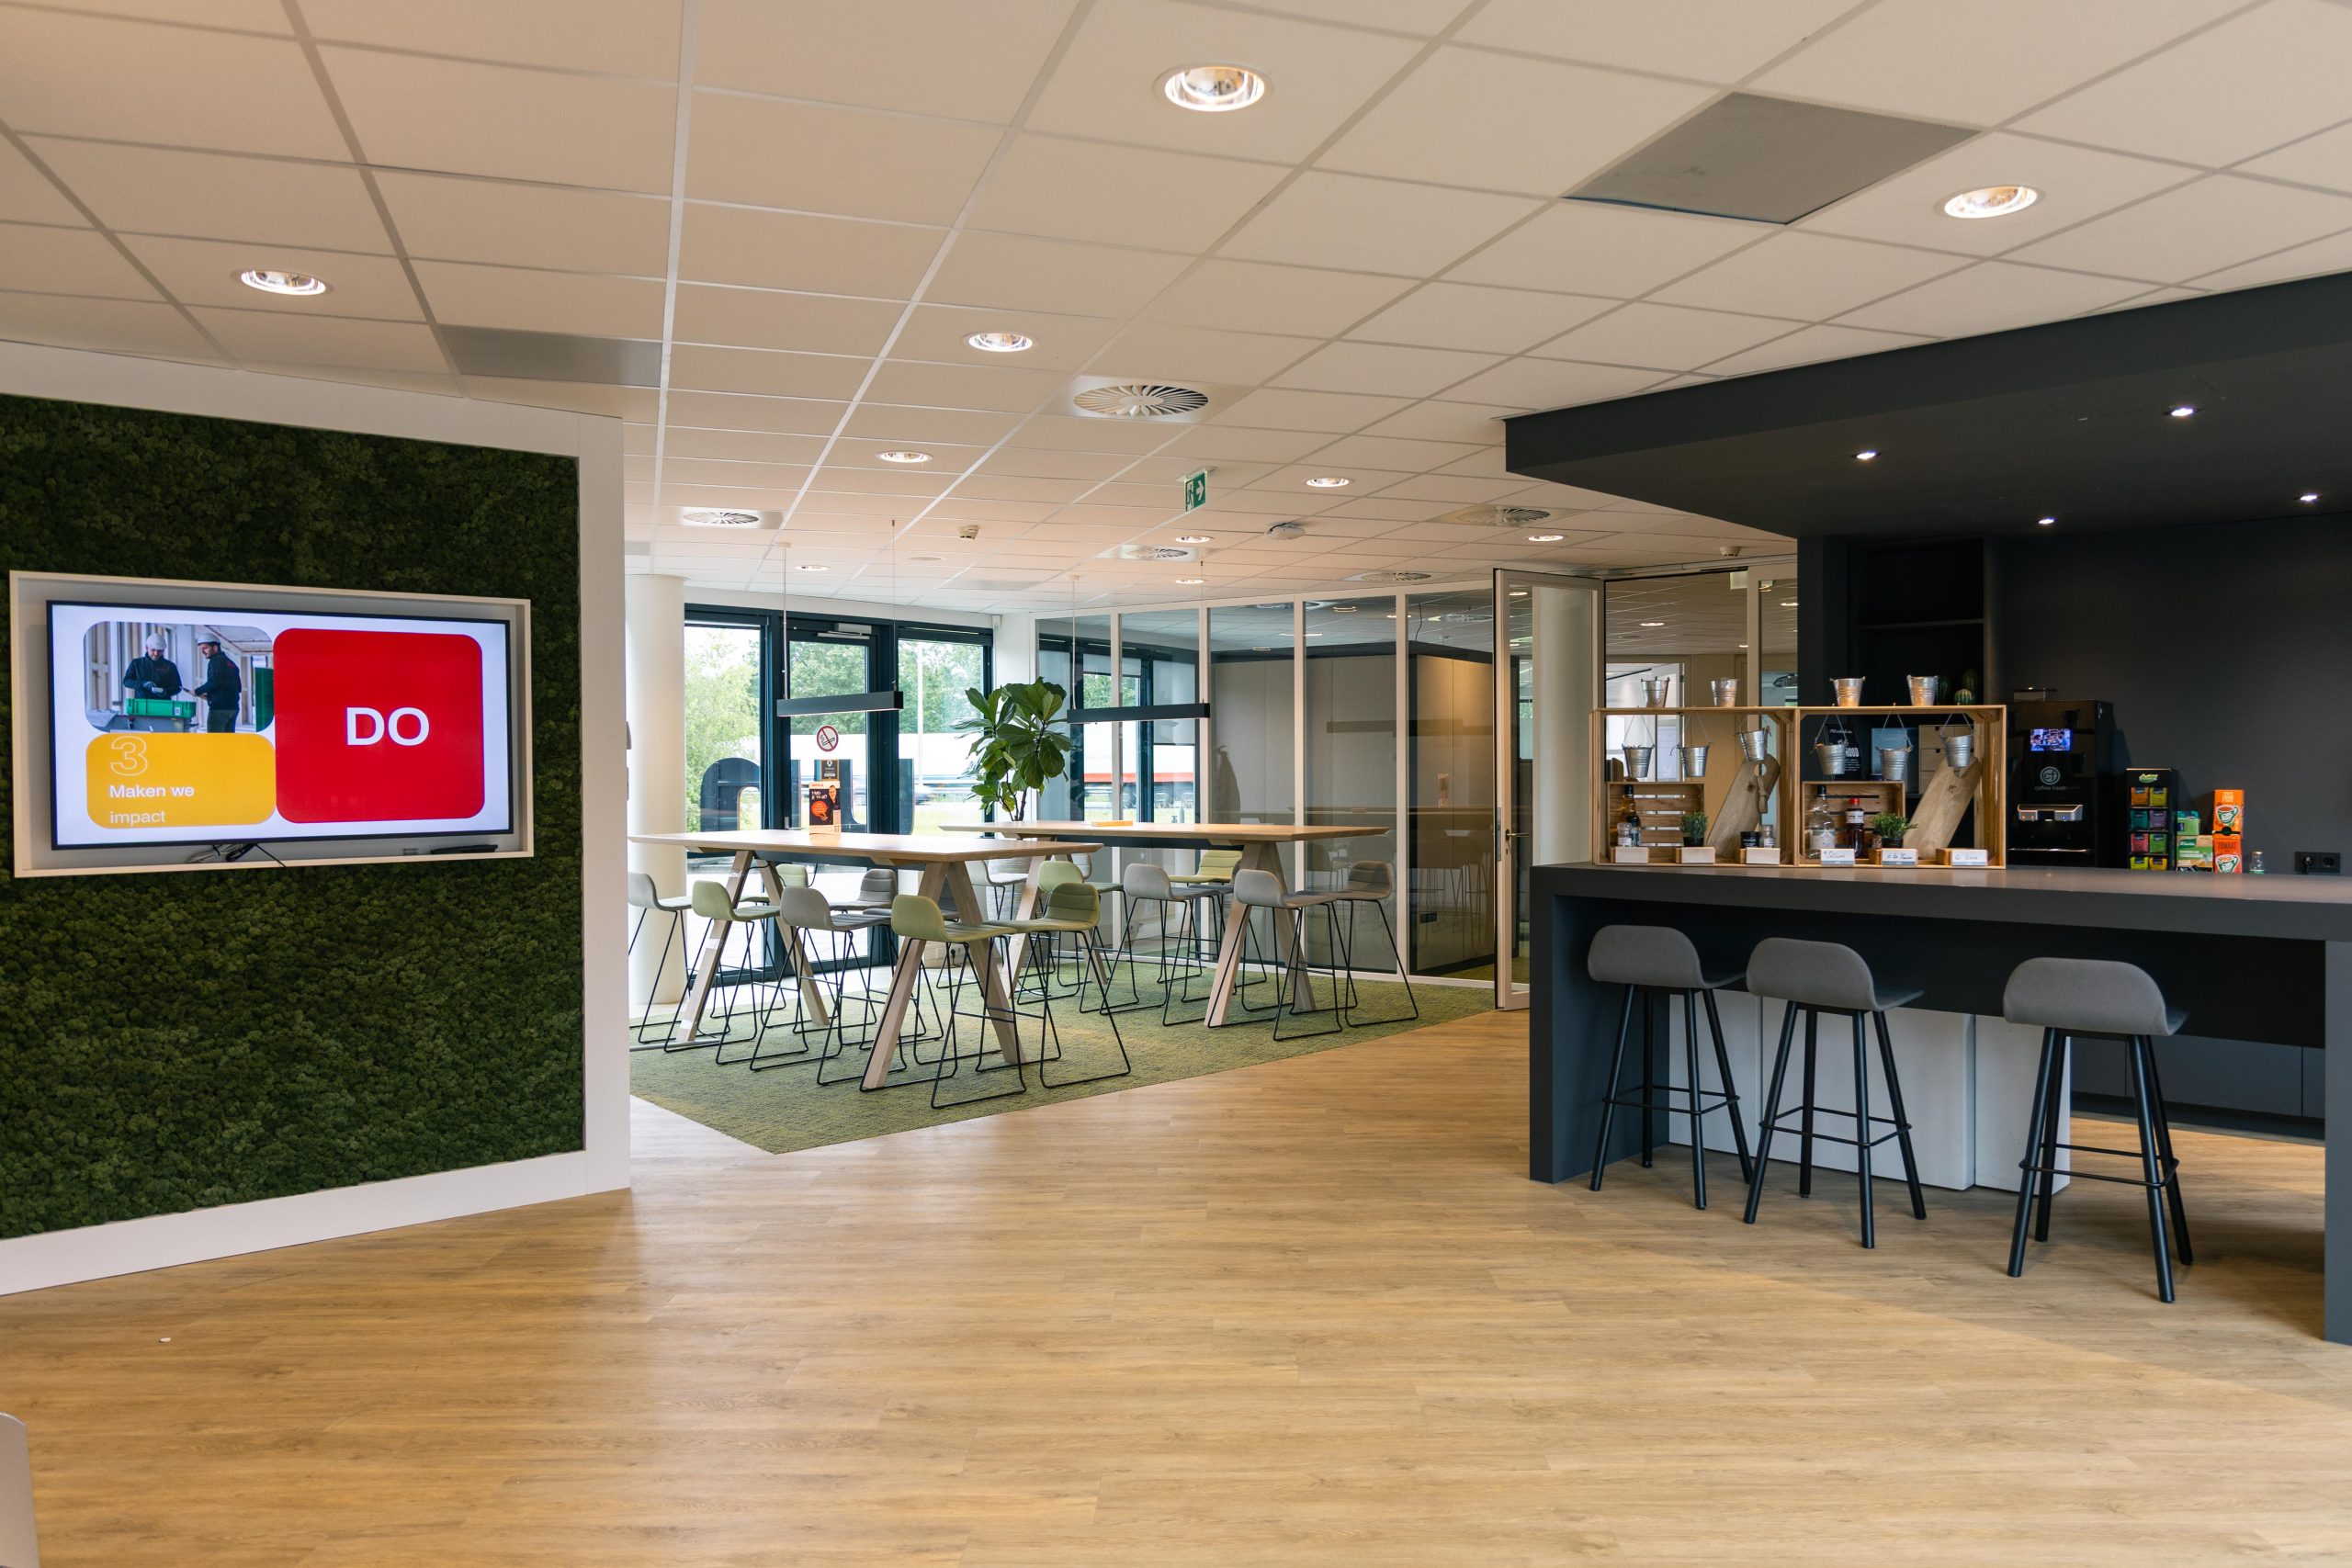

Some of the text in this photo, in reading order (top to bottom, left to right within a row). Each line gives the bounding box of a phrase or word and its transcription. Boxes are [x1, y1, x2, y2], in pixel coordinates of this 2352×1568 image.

[345, 706, 430, 747] DO
[110, 735, 149, 777] 3
[109, 784, 196, 798] Maken we
[110, 810, 166, 826] impact
